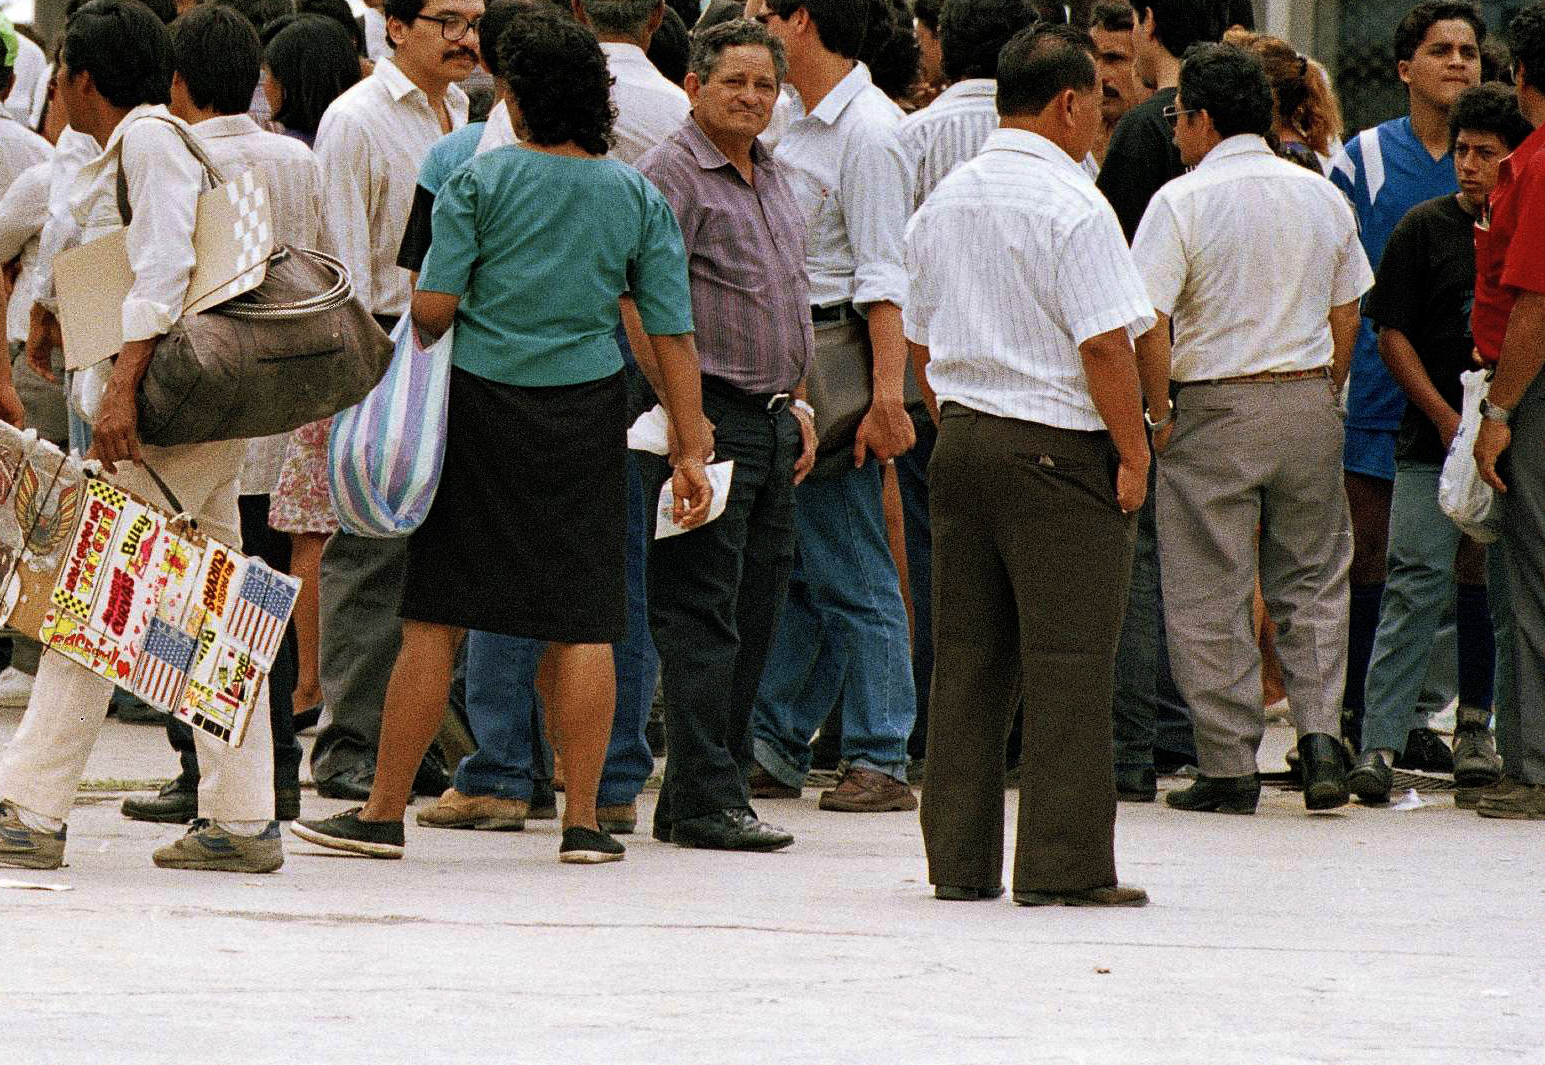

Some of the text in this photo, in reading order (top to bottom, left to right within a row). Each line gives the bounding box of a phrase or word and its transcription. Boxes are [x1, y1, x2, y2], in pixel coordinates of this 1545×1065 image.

[202, 548, 226, 612] CURVAS
[216, 575, 229, 605] PASES
[223, 559, 236, 576] NO
[110, 571, 135, 636] CURVAS
